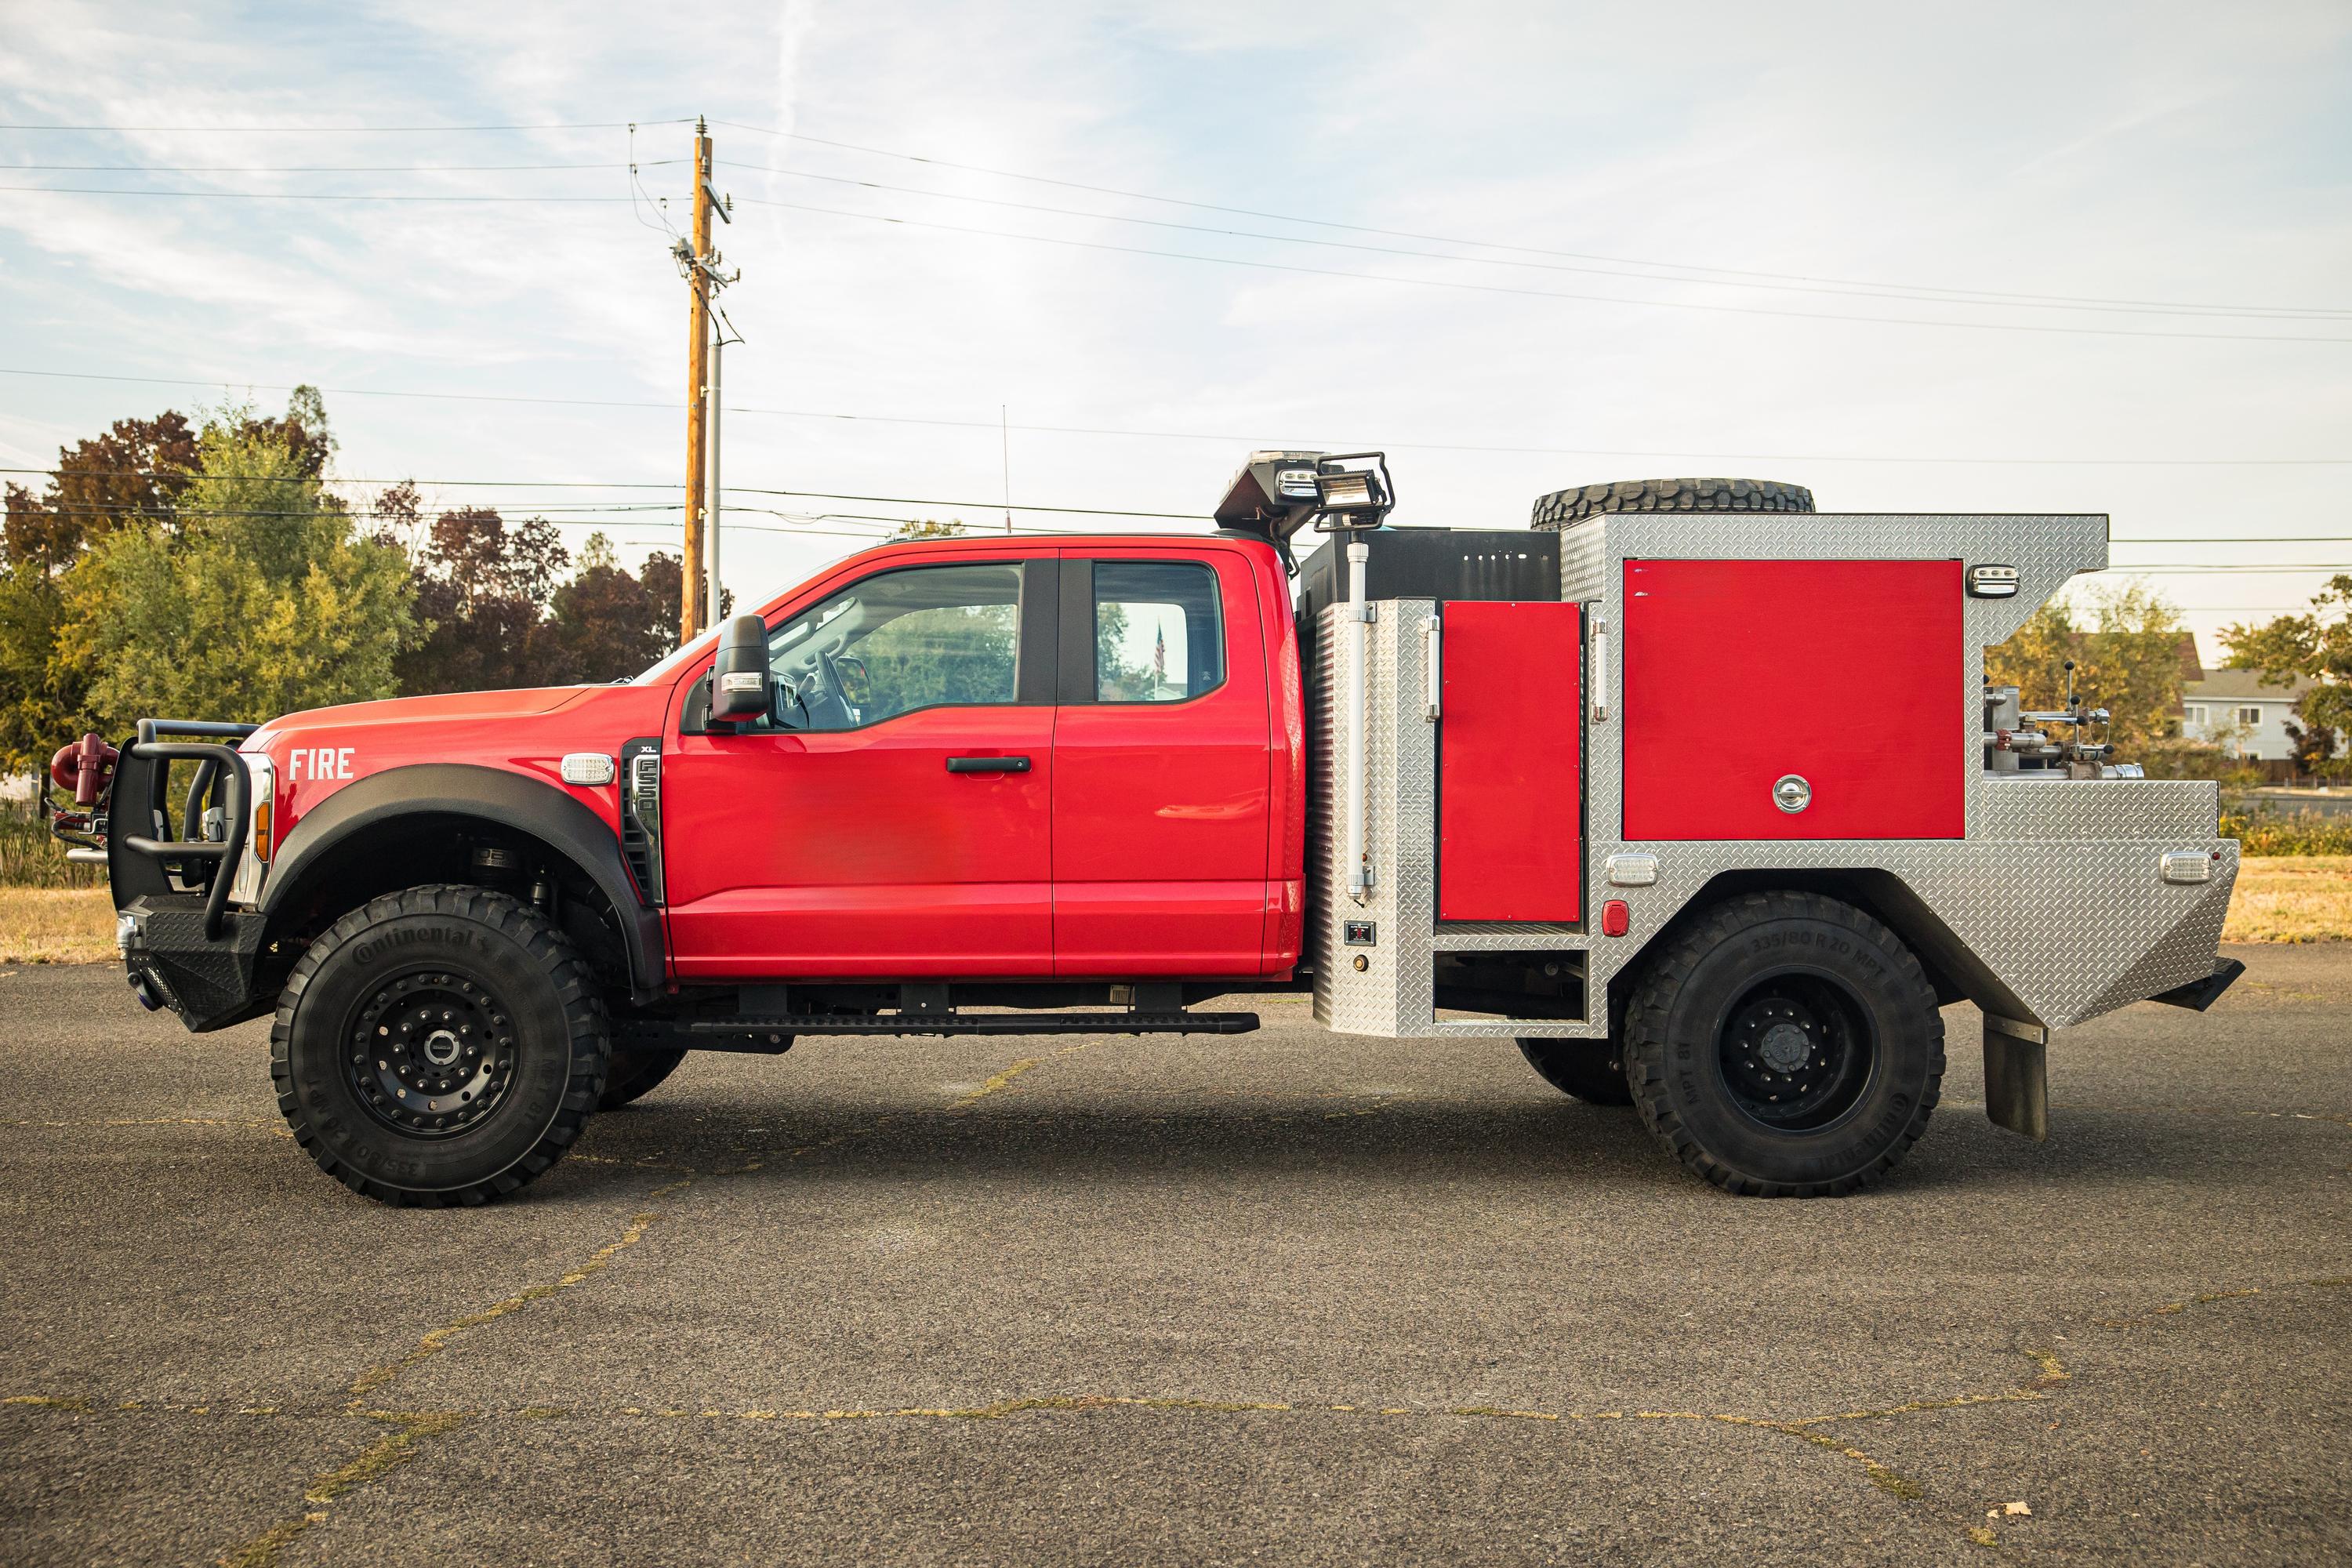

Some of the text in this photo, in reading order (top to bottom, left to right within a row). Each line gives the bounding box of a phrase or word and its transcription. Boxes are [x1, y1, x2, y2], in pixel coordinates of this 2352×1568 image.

[289, 747, 355, 780] FIRE
[350, 926, 473, 965] Continental
[1751, 931, 1886, 979] 335/80 R 20 MPT
